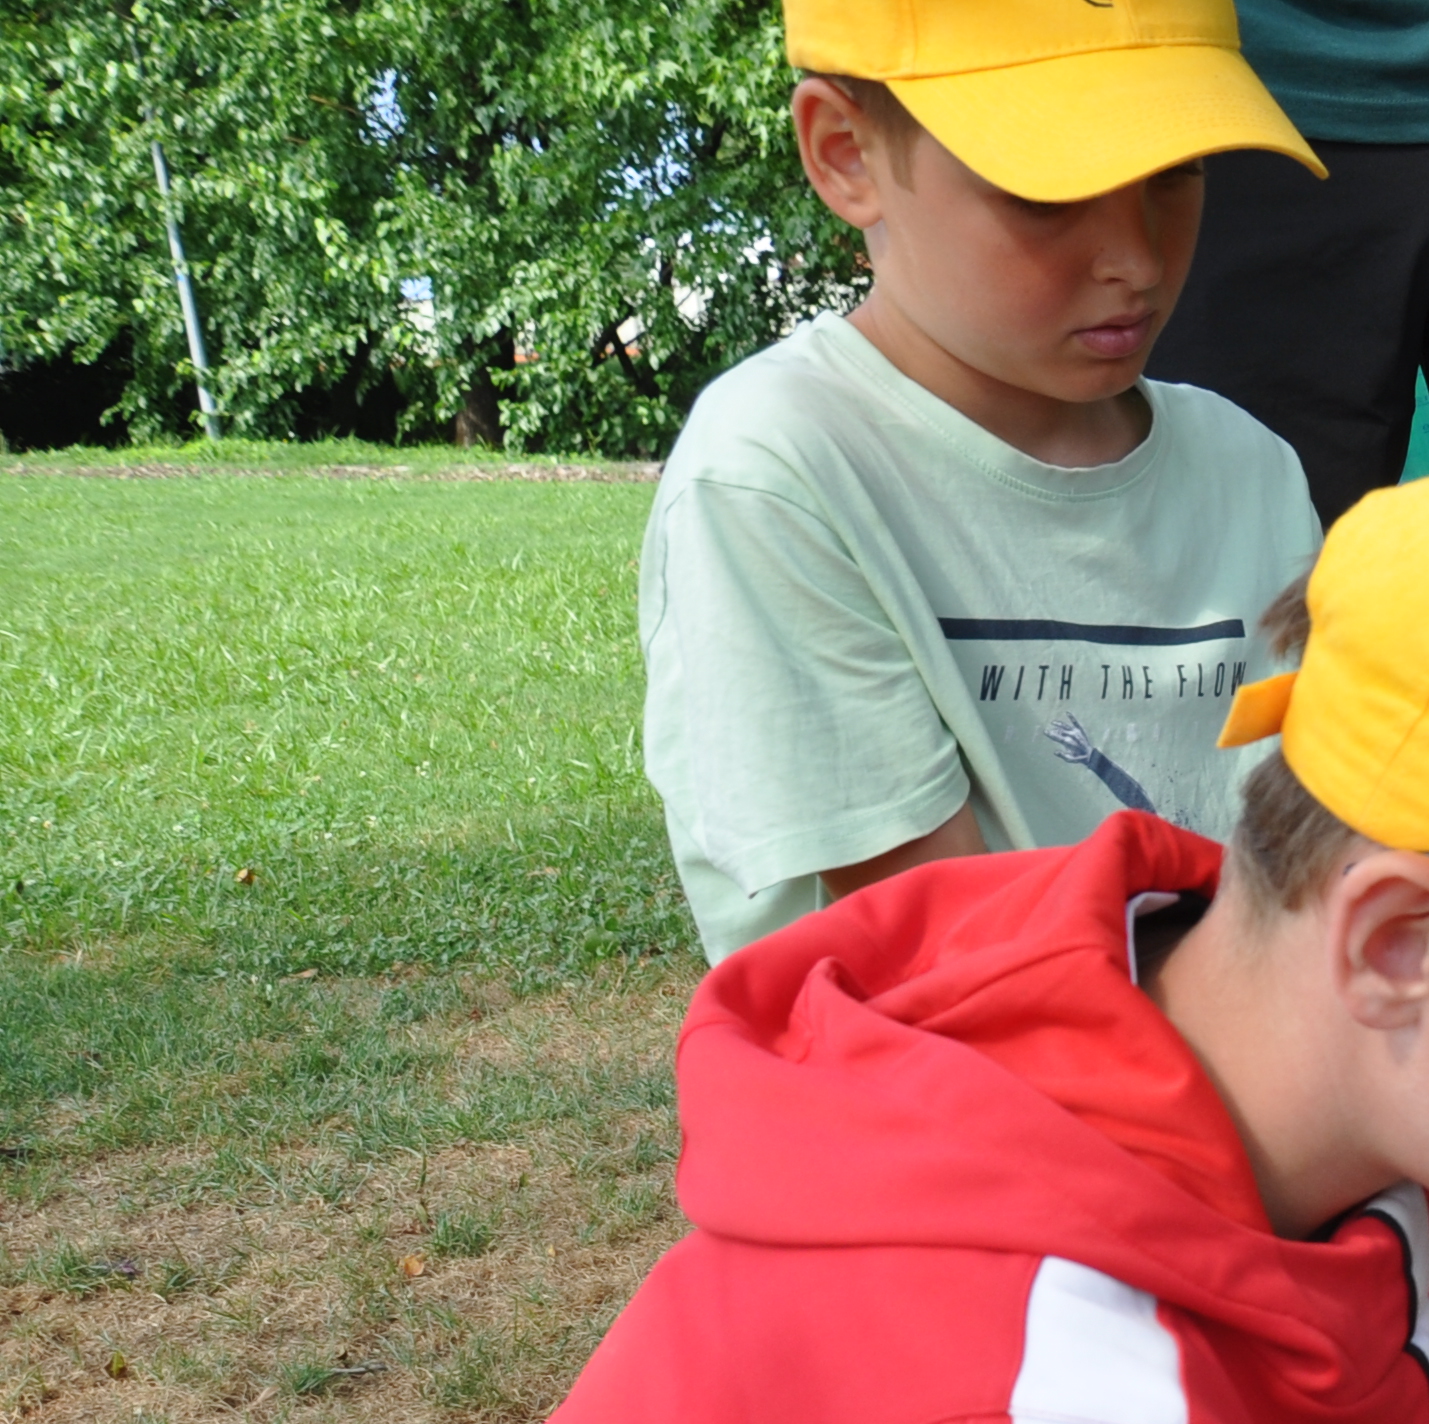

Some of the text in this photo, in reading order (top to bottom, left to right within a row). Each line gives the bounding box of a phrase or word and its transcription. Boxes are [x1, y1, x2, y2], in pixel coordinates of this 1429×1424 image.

[980, 661, 1247, 701] WITH THE FLOW
